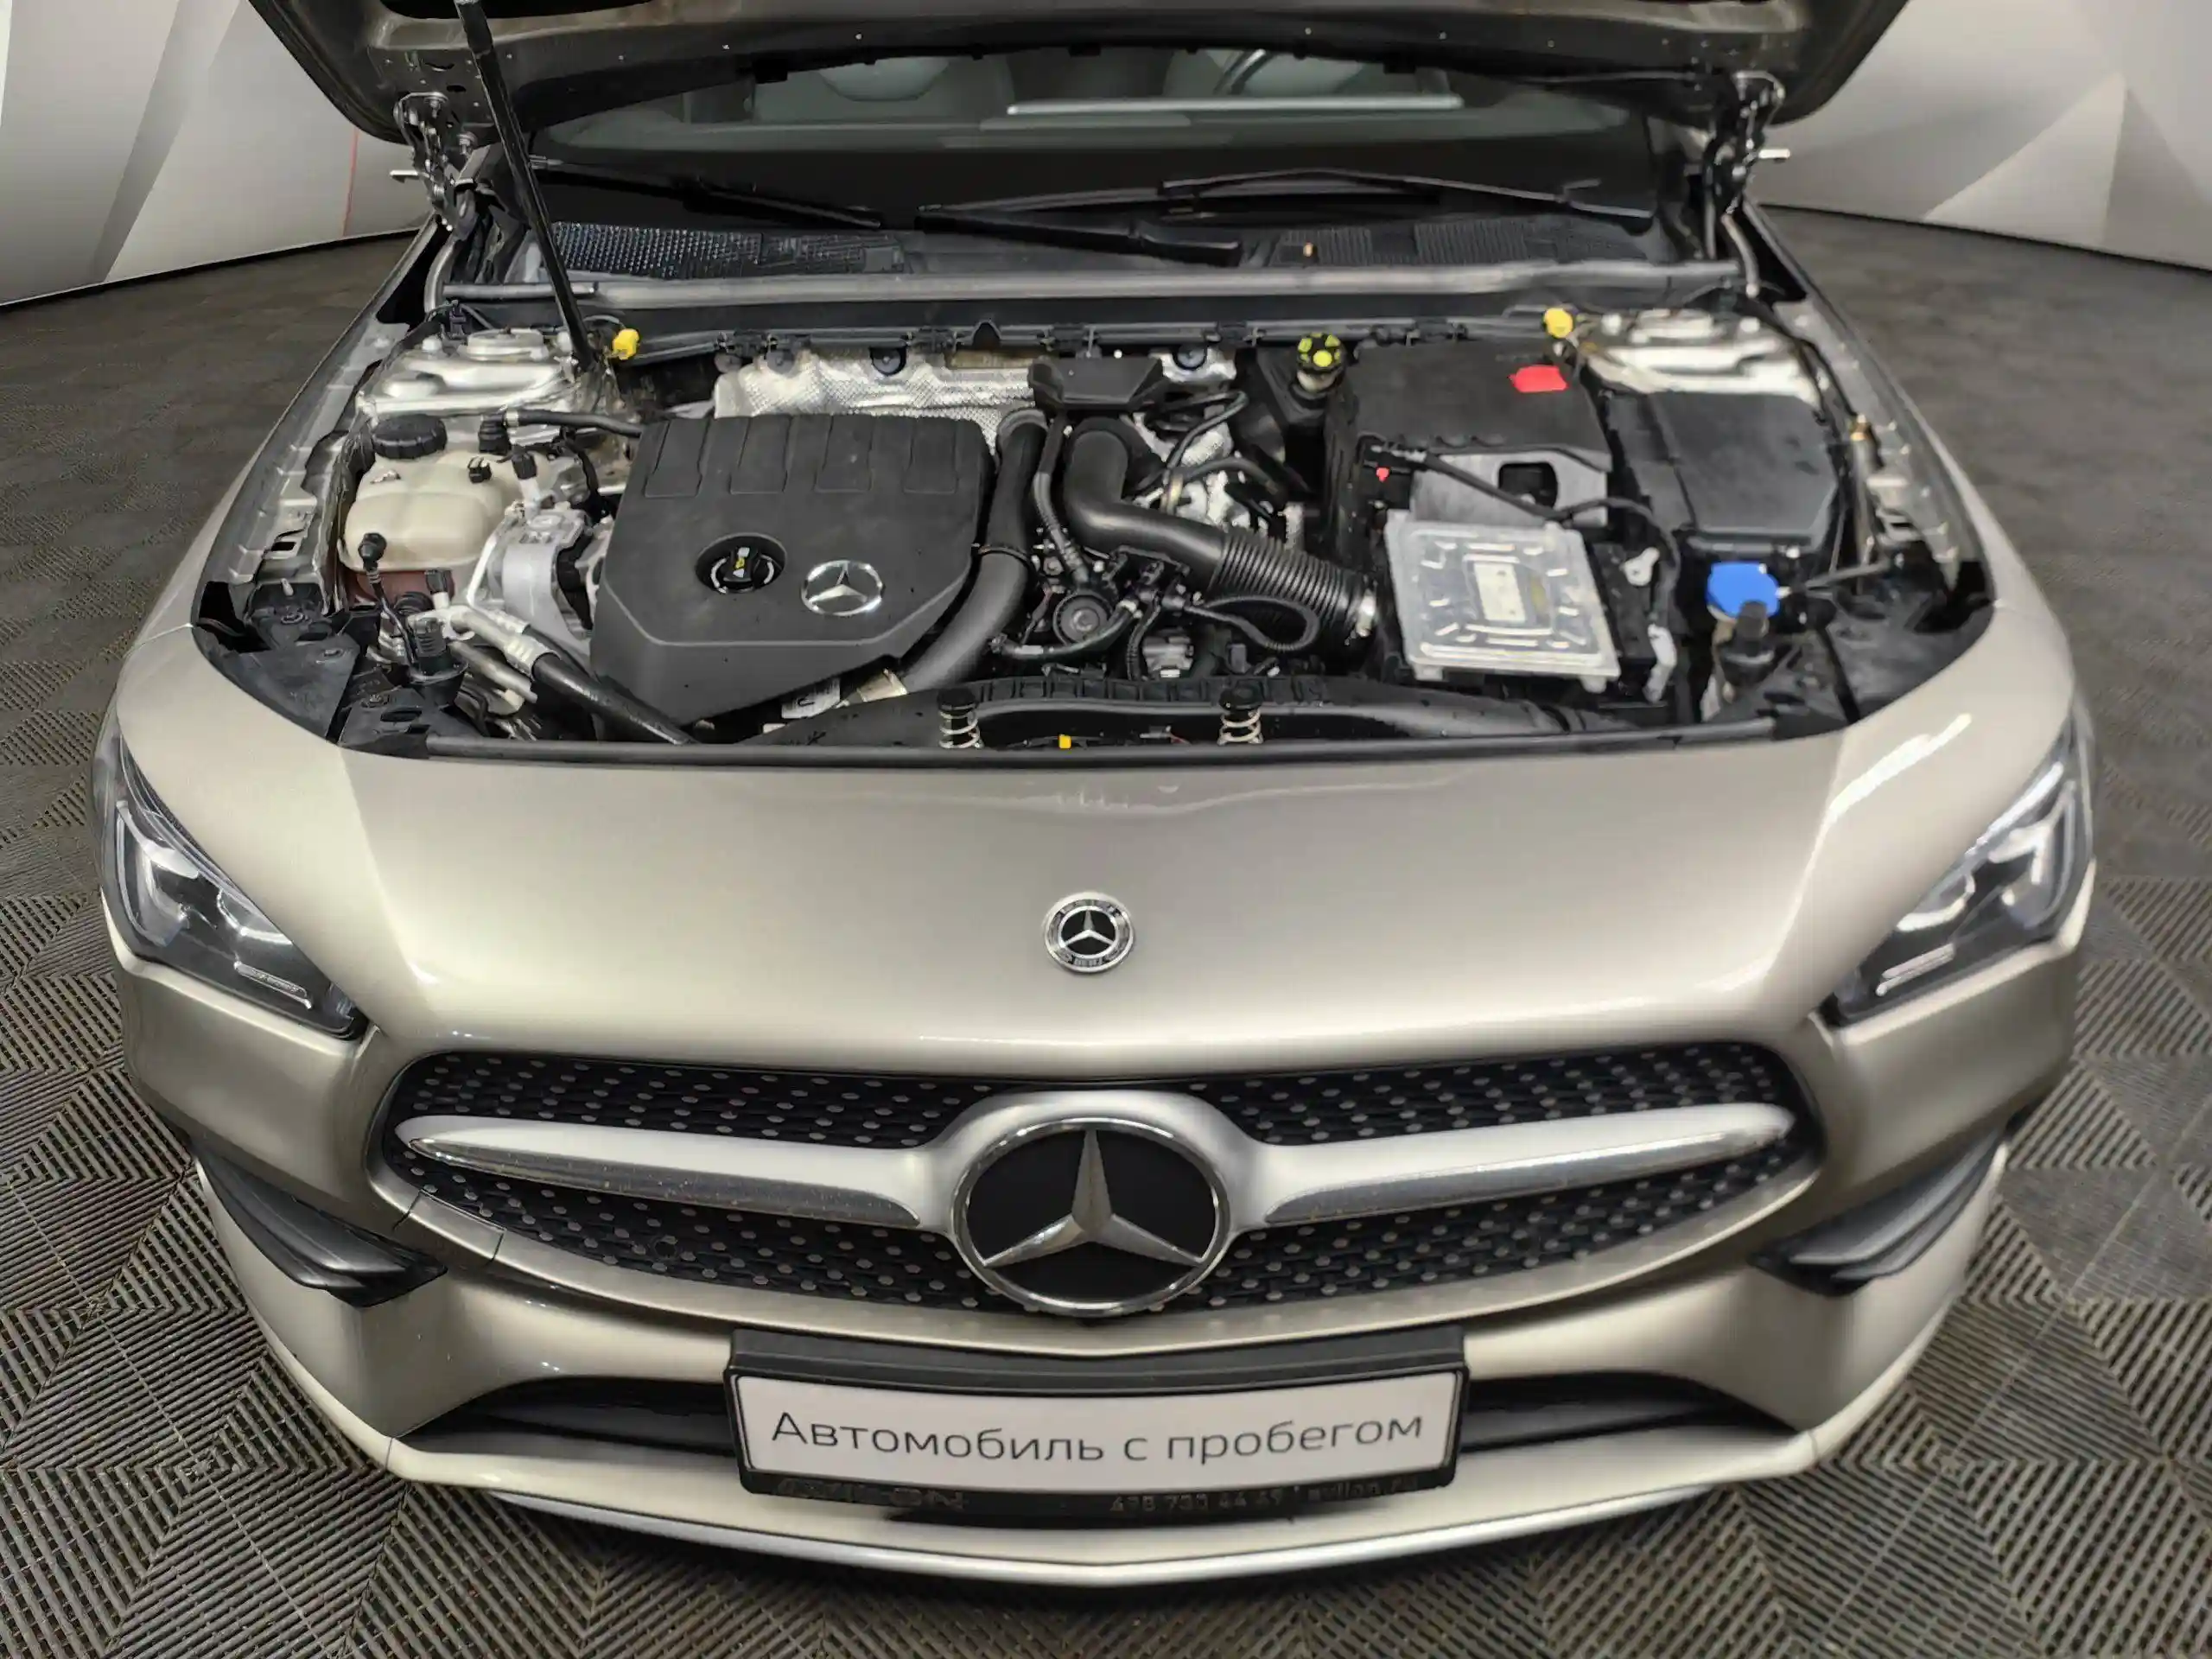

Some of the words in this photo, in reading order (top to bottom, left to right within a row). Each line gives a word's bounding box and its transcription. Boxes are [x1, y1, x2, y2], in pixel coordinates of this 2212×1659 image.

[772, 1411, 1104, 1461] Автомобиль
[1123, 1437, 1148, 1461] с
[1167, 1415, 1423, 1465] пробегом
